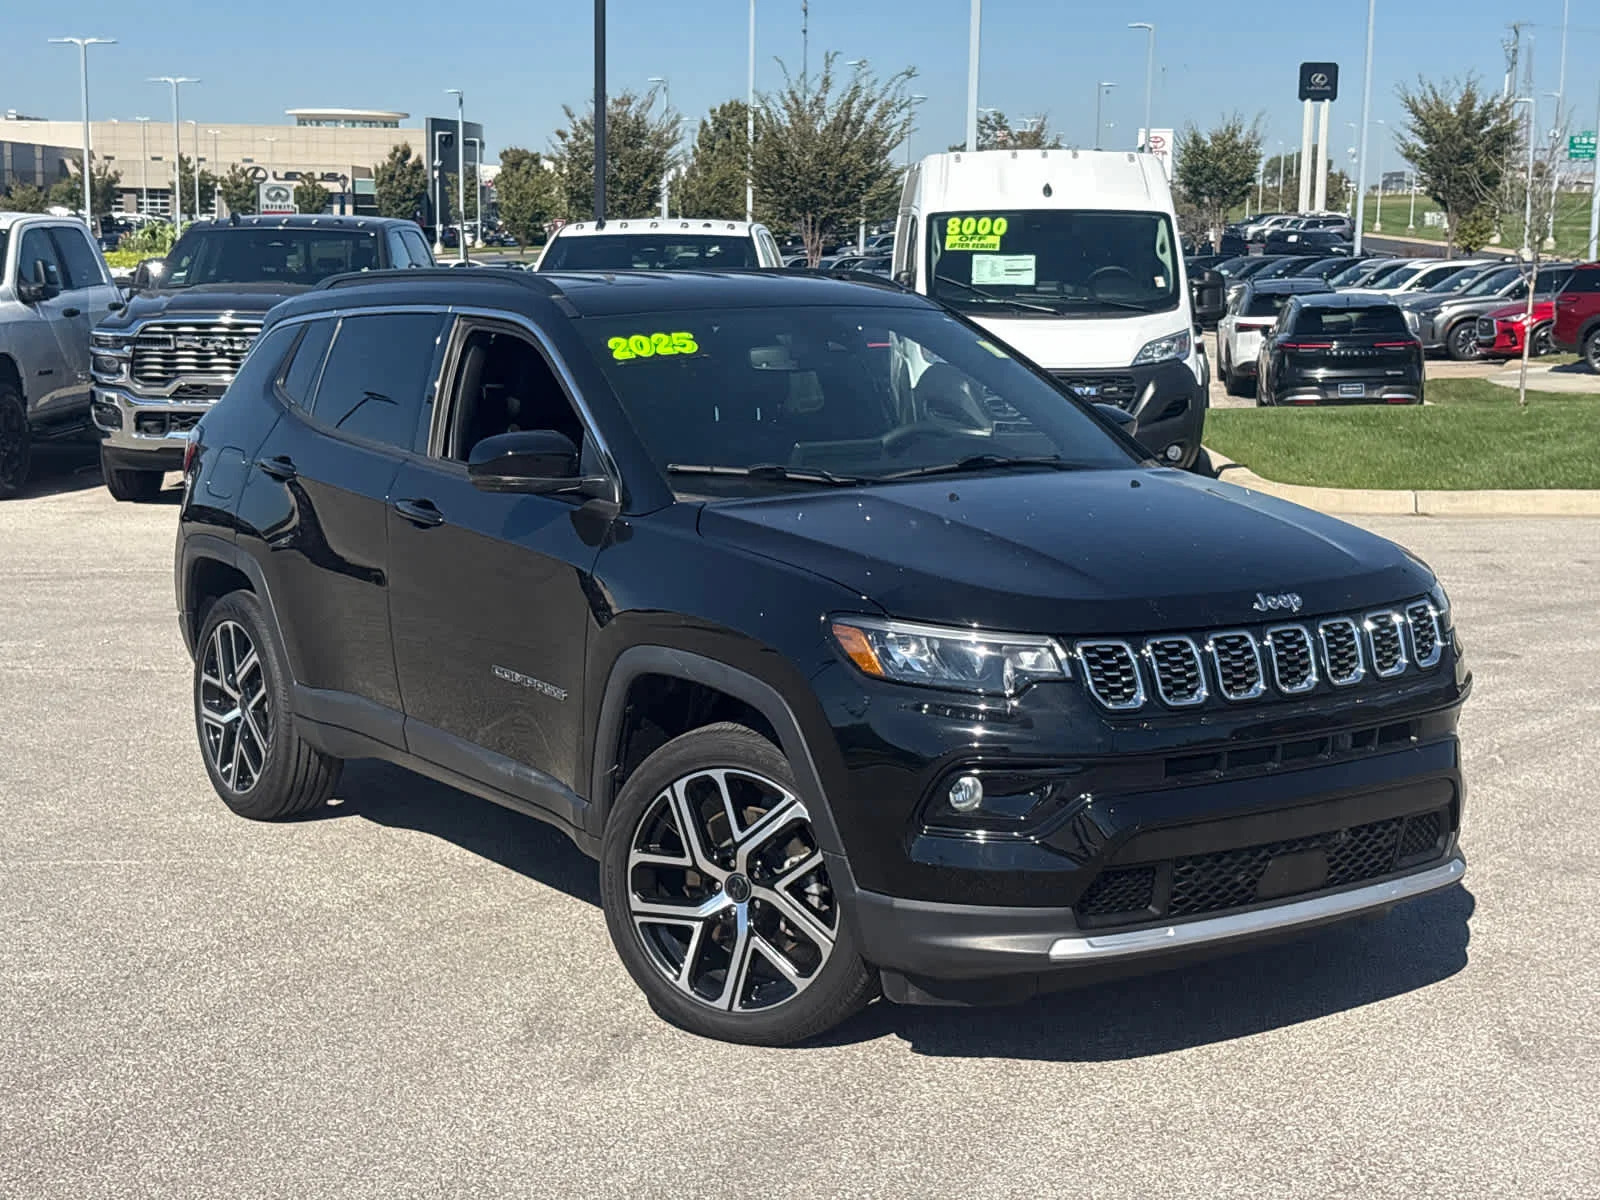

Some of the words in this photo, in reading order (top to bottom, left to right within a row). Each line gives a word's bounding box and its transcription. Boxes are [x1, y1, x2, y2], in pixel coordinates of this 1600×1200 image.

[946, 217, 1008, 236] 8000
[607, 332, 699, 360] 2025
[1252, 592, 1303, 613] Jeep
